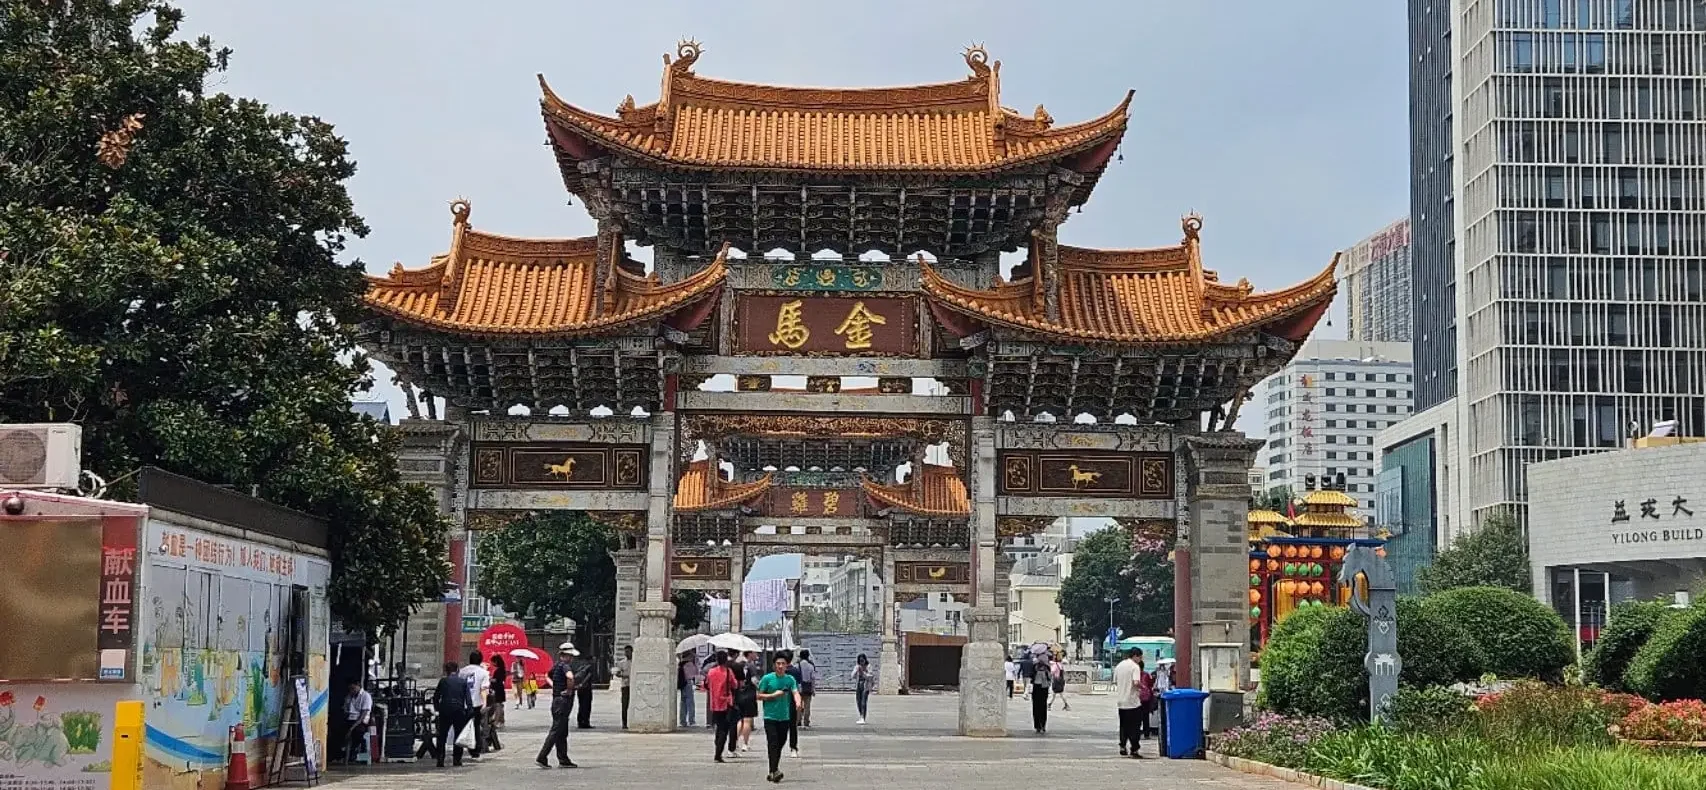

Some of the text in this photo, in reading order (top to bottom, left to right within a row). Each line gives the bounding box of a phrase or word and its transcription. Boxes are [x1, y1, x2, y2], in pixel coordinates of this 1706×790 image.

[1612, 528, 1703, 544] YILONG BUILD
[102, 547, 135, 635] 献血车
